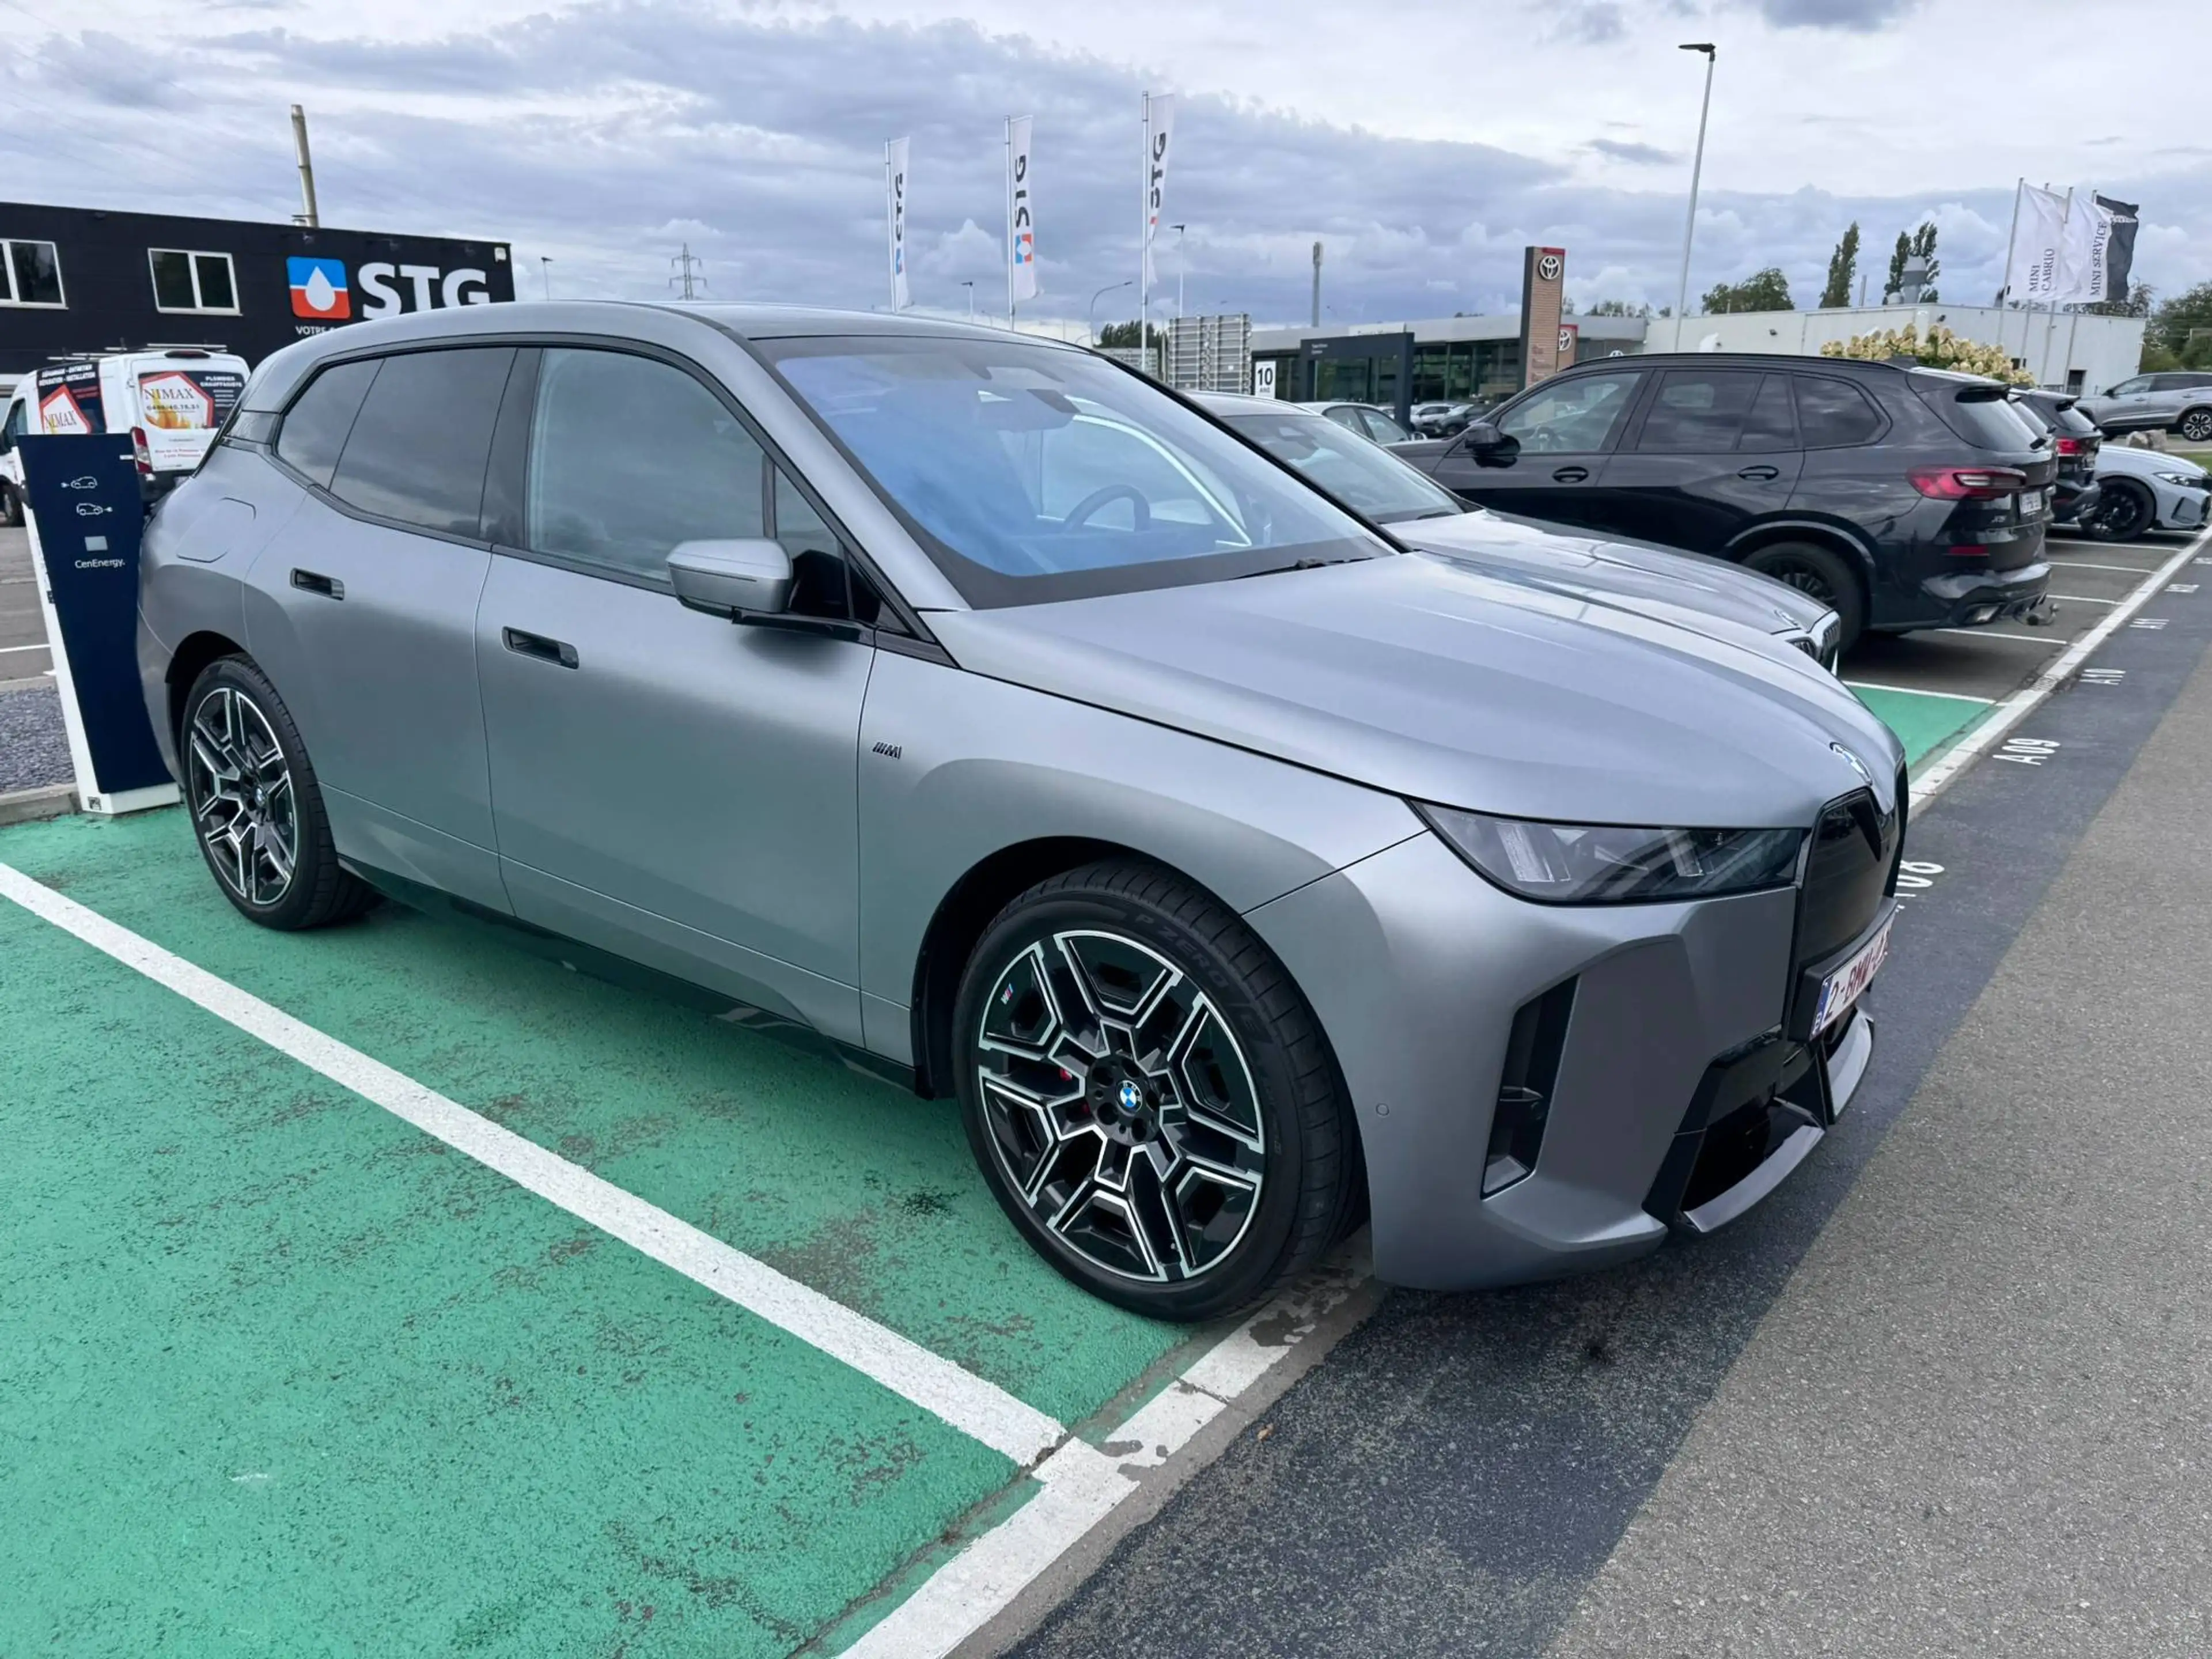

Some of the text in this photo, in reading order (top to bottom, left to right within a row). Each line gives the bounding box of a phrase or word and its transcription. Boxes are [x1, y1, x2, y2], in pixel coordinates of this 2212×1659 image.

[1015, 155, 1030, 229] STG
[2029, 265, 2040, 293] MINI
[2041, 248, 2055, 291] CABRIO
[357, 262, 490, 319] STG
[2089, 270, 2102, 297] MINI
[1257, 368, 1273, 386] 10
[144, 388, 195, 400] NIMAX
[44, 411, 77, 428] NIMAX
[2078, 668, 2126, 685] A10
[1993, 738, 2061, 766] A09
